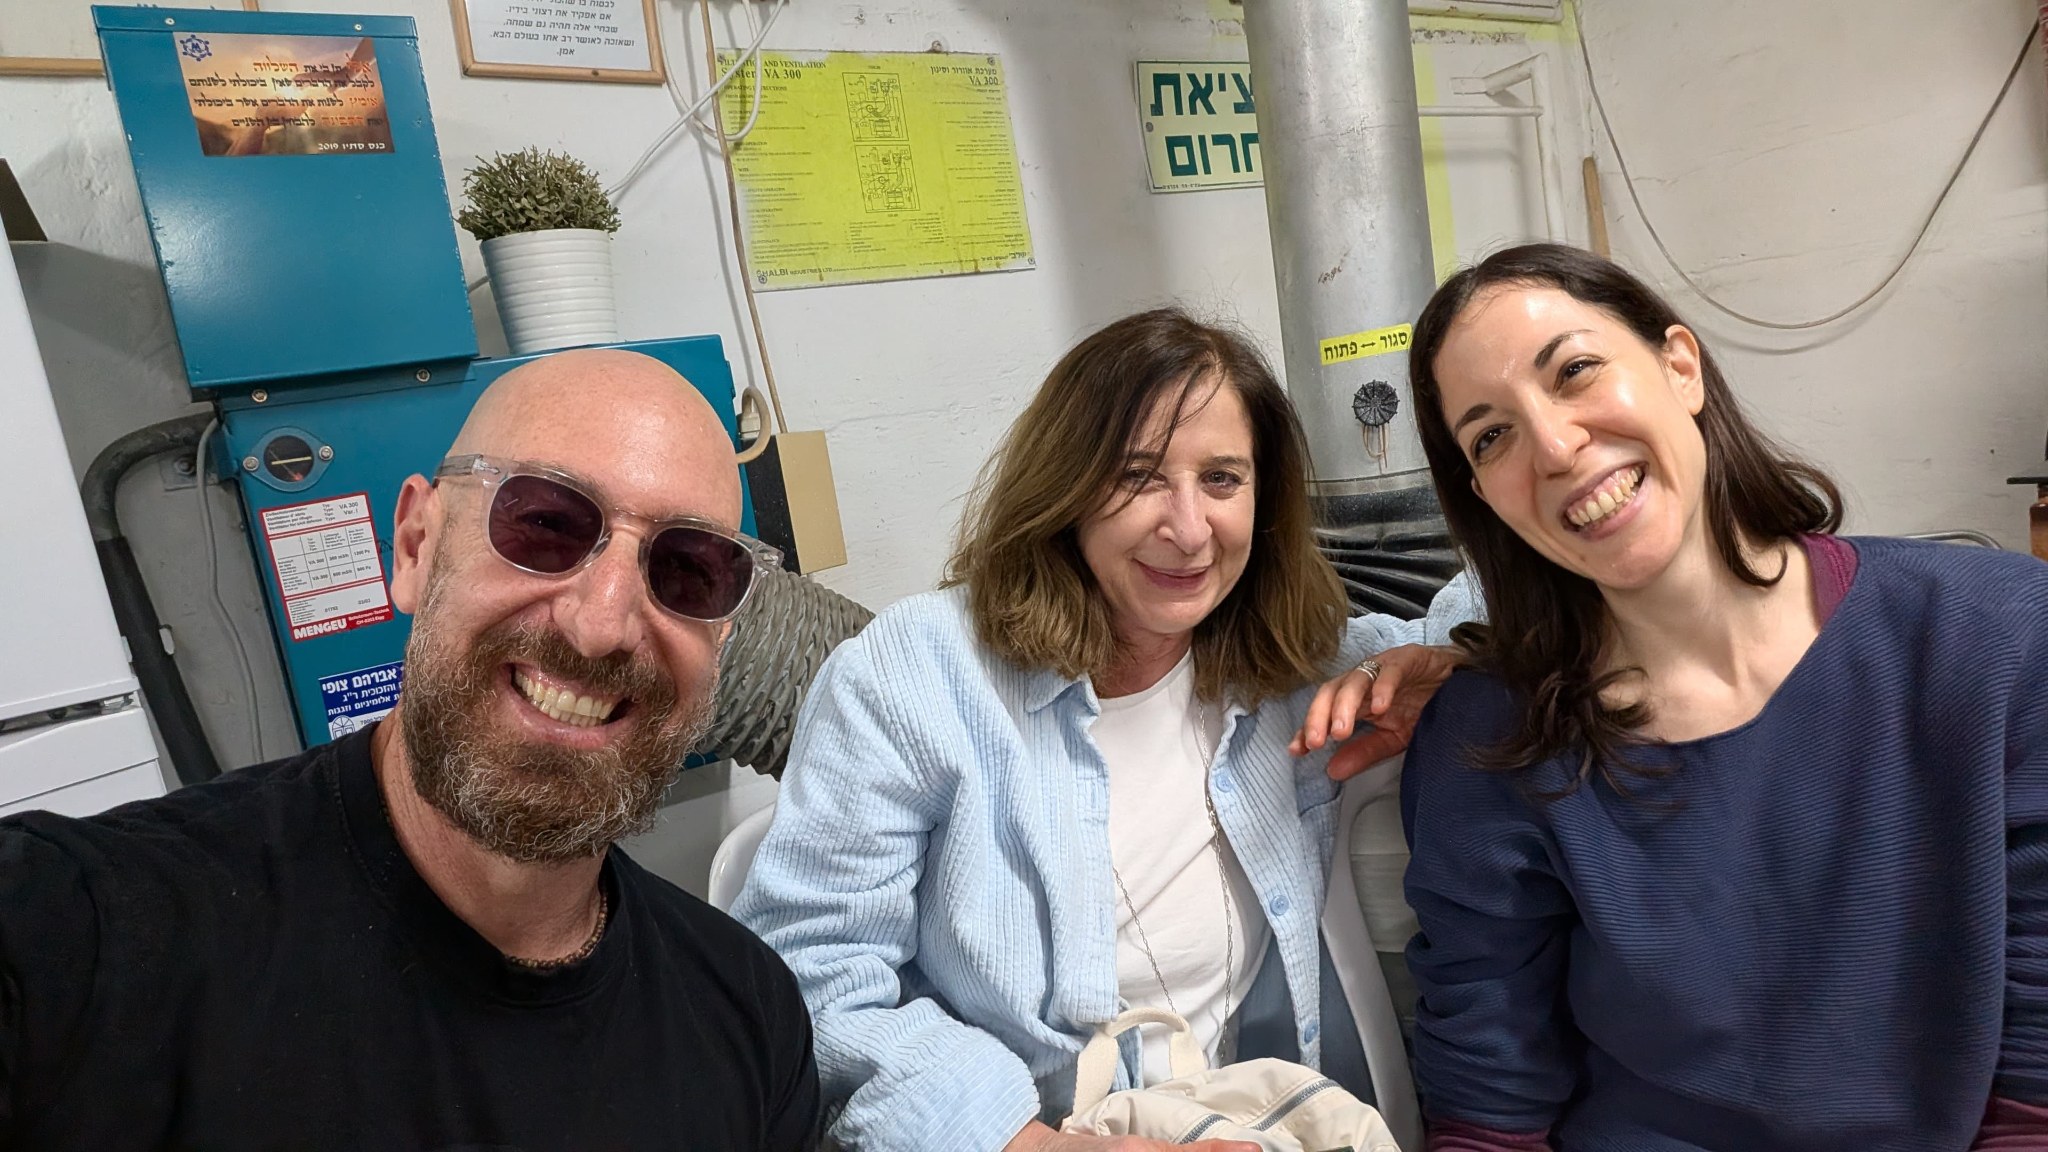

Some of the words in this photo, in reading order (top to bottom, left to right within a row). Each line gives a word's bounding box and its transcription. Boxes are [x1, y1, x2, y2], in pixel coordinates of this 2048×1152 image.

[532, 7, 553, 16] רצוני
[555, 9, 568, 17] את
[570, 11, 597, 19] אפקיד
[535, 20, 547, 28] גם
[573, 23, 591, 31] אלה
[514, 31, 540, 41] בעולם
[560, 35, 573, 43] רב
[575, 36, 602, 45] לאושר
[253, 55, 299, 72] השלווה
[303, 64, 319, 73] את
[780, 60, 826, 69] VENTILATION
[721, 67, 757, 80] Sste
[764, 69, 780, 80] VA
[783, 69, 802, 80] 300
[974, 67, 997, 76] מערכת
[188, 71, 227, 87] לשנותם
[228, 71, 267, 87] ביכולתי
[271, 77, 293, 92] שאין
[294, 78, 333, 88] הדברים
[346, 73, 375, 92] לקבל
[969, 75, 982, 86] VA
[984, 76, 999, 86] 300
[193, 91, 234, 107] ביכולתי
[317, 91, 344, 107] לשנות
[1150, 73, 1256, 116] ציאת
[235, 97, 259, 108] אשר
[259, 96, 299, 107] הדברים
[301, 97, 316, 107] את
[318, 142, 339, 151] 2019
[342, 142, 365, 150] סתיו
[367, 142, 386, 150] כנס
[1379, 331, 1408, 350] סגור
[1323, 340, 1359, 361] פתוח
[293, 618, 347, 639] MENGEU
[352, 668, 397, 688] אברהם
[322, 679, 349, 694] צופי
[361, 684, 396, 698] והזכוכית
[354, 696, 391, 710] אלומיניום
[327, 705, 352, 716] וזגגות
